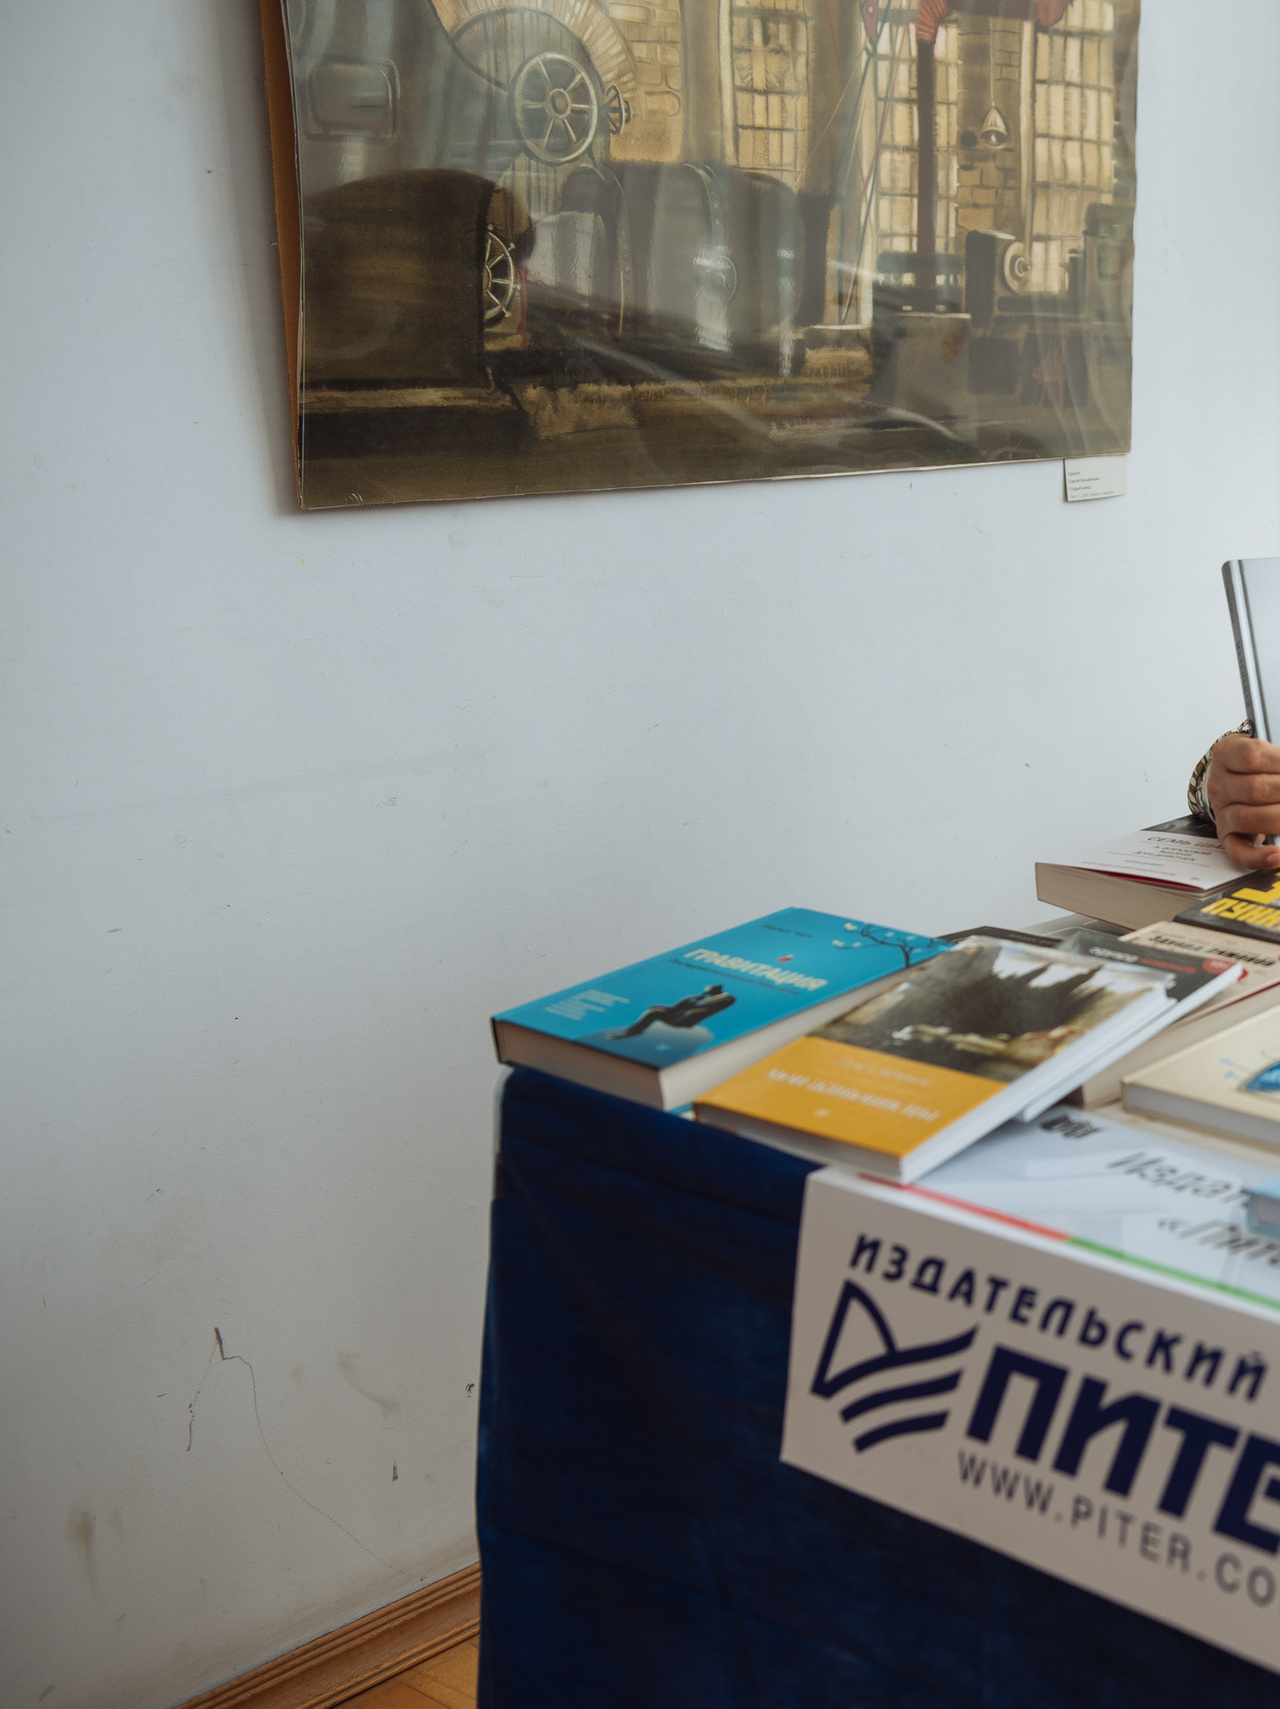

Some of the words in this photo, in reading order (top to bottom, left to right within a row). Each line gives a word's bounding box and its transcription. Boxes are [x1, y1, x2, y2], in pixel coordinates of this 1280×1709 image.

[683, 947, 829, 992] ГРАВИТАЦИЯ
[1106, 1150, 1250, 1209] Издат
[848, 1232, 1269, 1406] ИЗДАТЕЛЬСКИЙ
